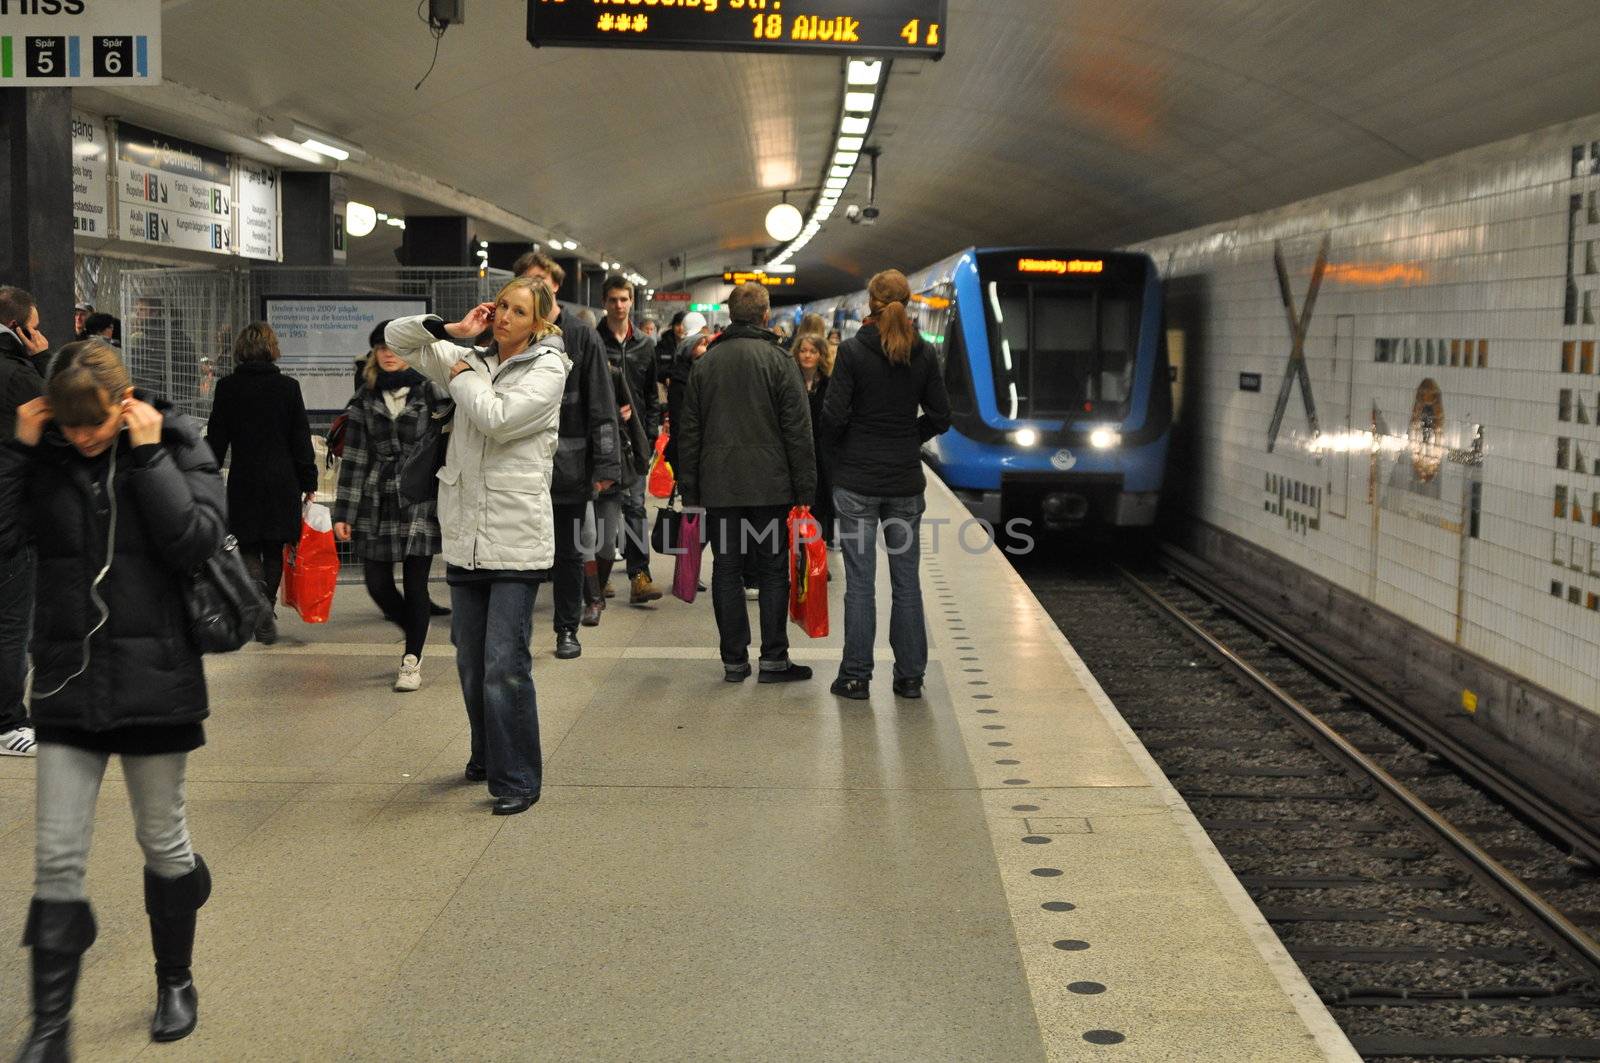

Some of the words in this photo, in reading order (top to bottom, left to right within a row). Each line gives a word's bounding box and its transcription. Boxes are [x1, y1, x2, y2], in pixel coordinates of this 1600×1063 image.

[753, 13, 782, 39] 18
[791, 15, 859, 42] Alvik
[900, 19, 919, 44] 4
[35, 39, 55, 48] Spår
[103, 39, 122, 48] Spår
[37, 51, 54, 74] 5
[104, 51, 122, 74] 6
[271, 304, 293, 313] Under
[317, 304, 337, 313] 2009
